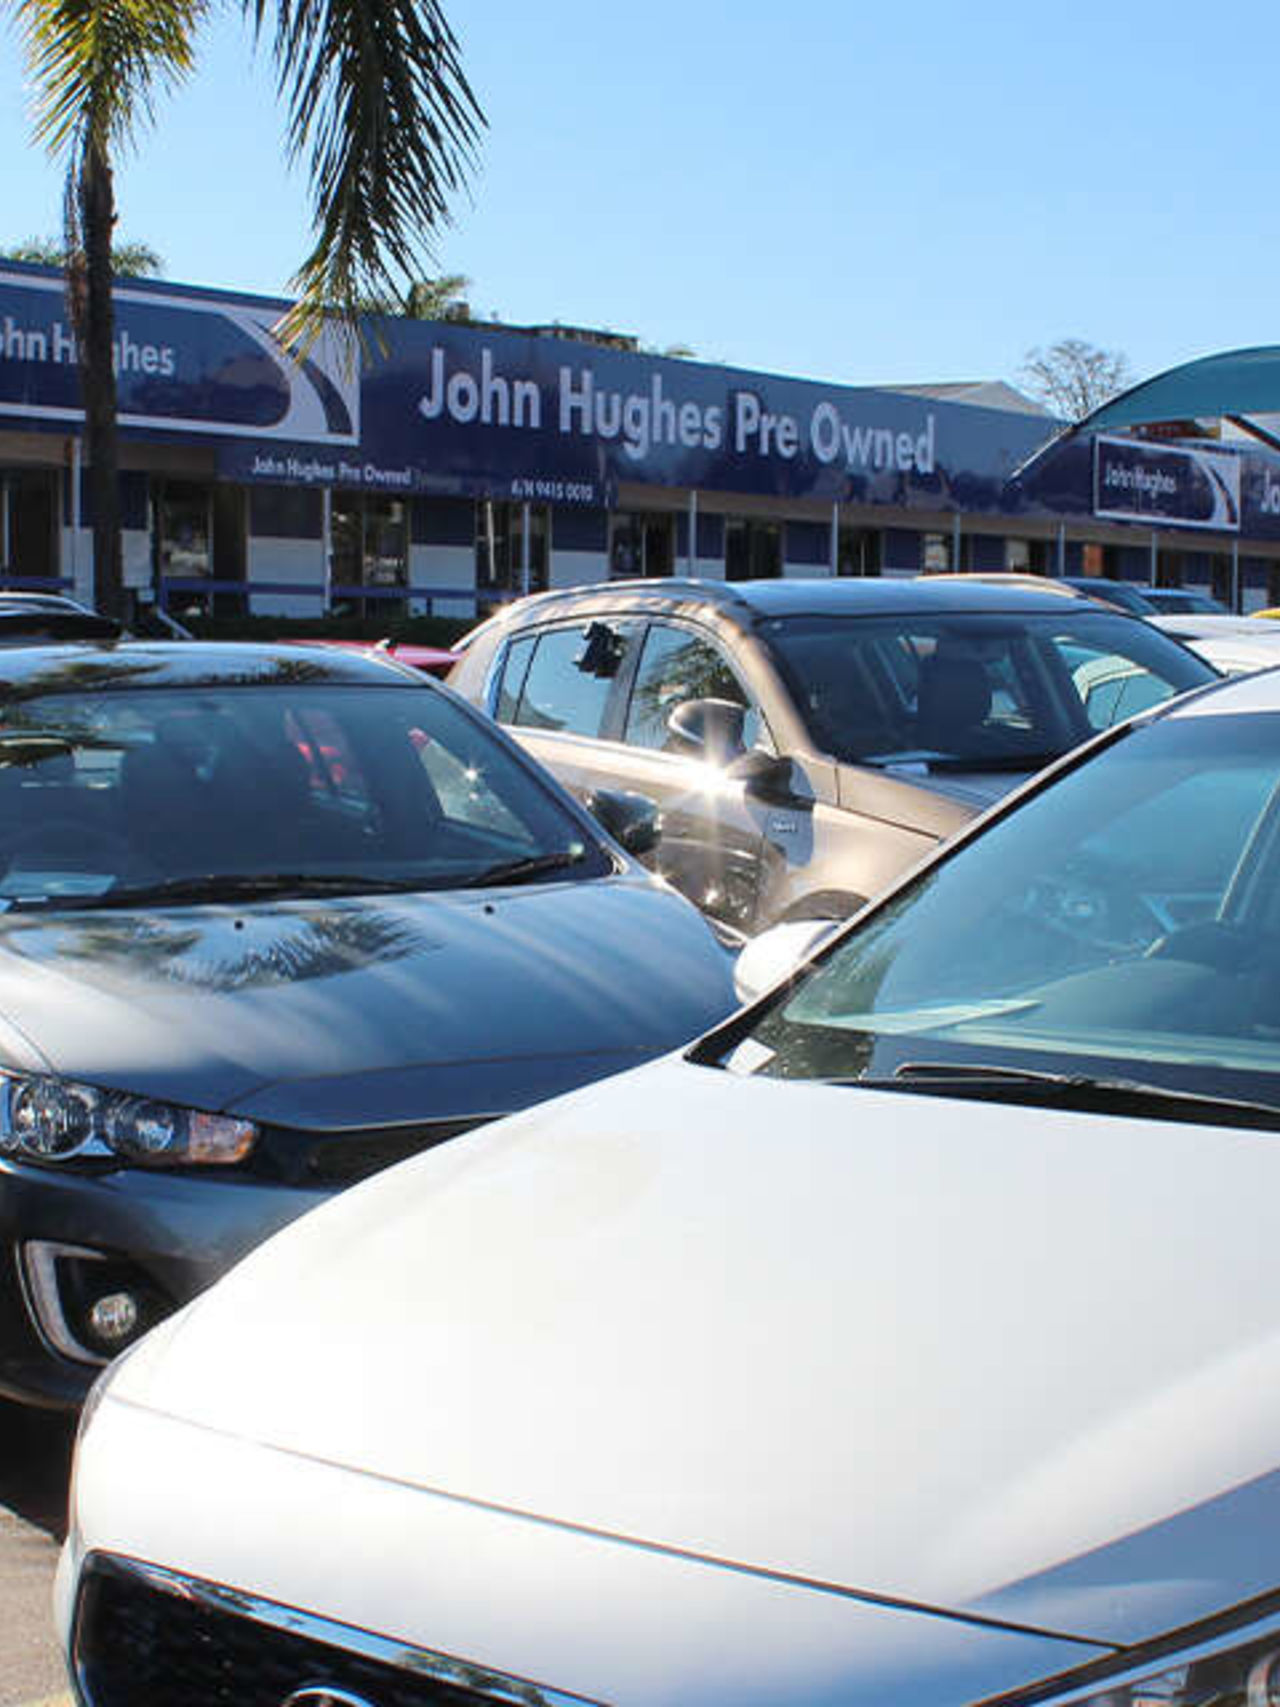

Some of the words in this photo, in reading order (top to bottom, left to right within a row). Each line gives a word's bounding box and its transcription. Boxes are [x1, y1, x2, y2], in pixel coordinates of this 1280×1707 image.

[420, 347, 540, 429] John
[559, 365, 720, 462] Hughes
[736, 391, 798, 459] Pre
[811, 402, 935, 475] Owned
